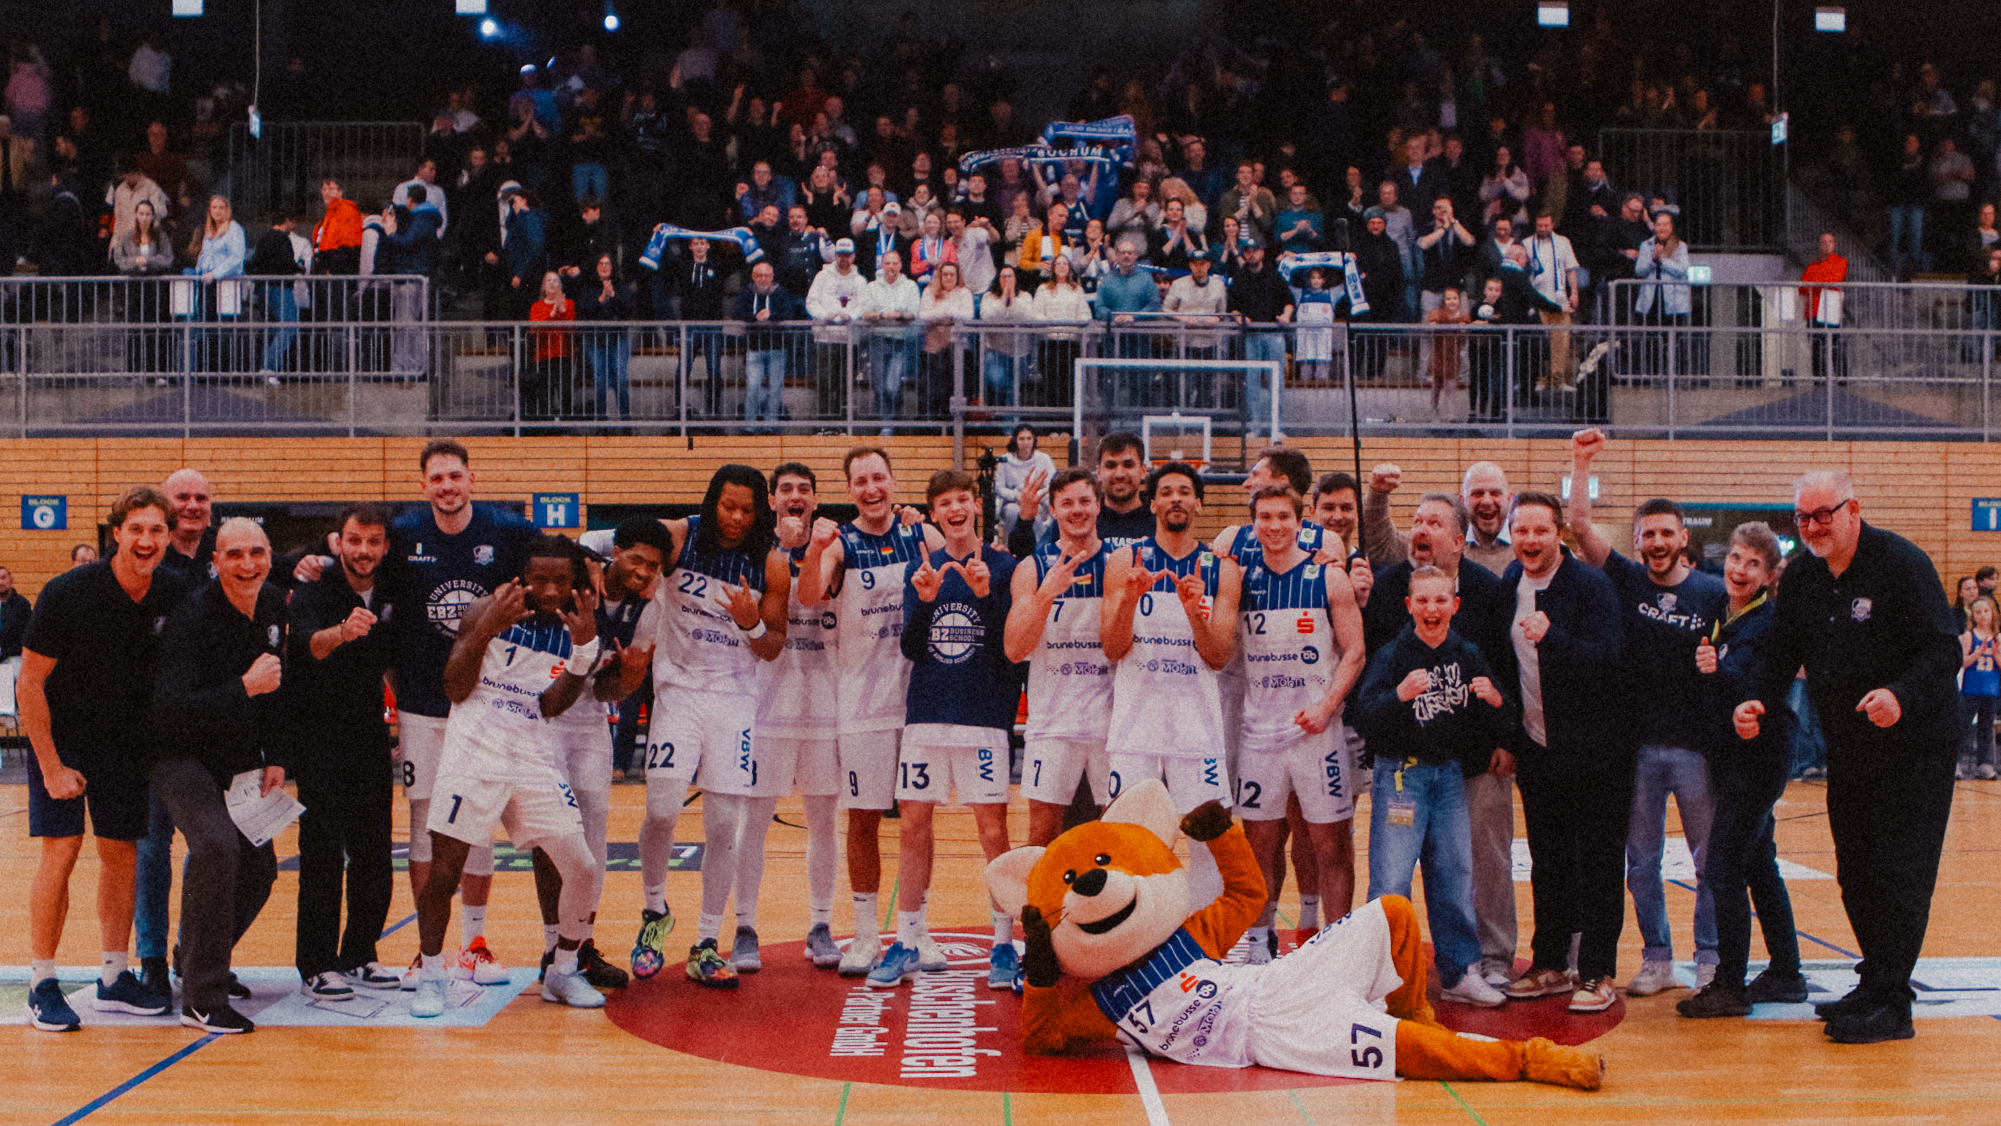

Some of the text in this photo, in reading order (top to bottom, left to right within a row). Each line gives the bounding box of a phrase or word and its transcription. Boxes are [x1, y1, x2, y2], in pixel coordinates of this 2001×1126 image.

[1037, 146, 1103, 157] BOCHUM
[33, 506, 55, 529] G
[546, 504, 565, 526] H
[429, 580, 488, 601] UNIVERSITY
[678, 572, 708, 598] 22
[861, 571, 875, 590] 9
[427, 605, 457, 619] EBZ
[1053, 601, 1065, 622] 7
[1140, 594, 1153, 616] 0
[1638, 602, 1690, 627] CRAFT
[929, 628, 949, 641] BZ
[950, 628, 984, 636] BUSINESS
[1244, 613, 1266, 635] 12
[505, 646, 518, 666] 1
[1247, 652, 1298, 662] brunebusse
[648, 742, 675, 769] 22
[740, 728, 751, 772] VBW
[403, 761, 415, 787] 8
[901, 762, 930, 789] 13
[978, 748, 994, 782] BW
[1034, 760, 1042, 787] 7
[1325, 750, 1343, 798] VBW
[849, 771, 859, 797] 9
[448, 794, 463, 824] 1
[839, 992, 895, 1025] Partner
[1127, 1000, 1155, 1034] 57
[900, 970, 1002, 1078] Buschenhofen
[829, 1026, 889, 1057] GmbH
[1351, 1023, 1383, 1068] 57
